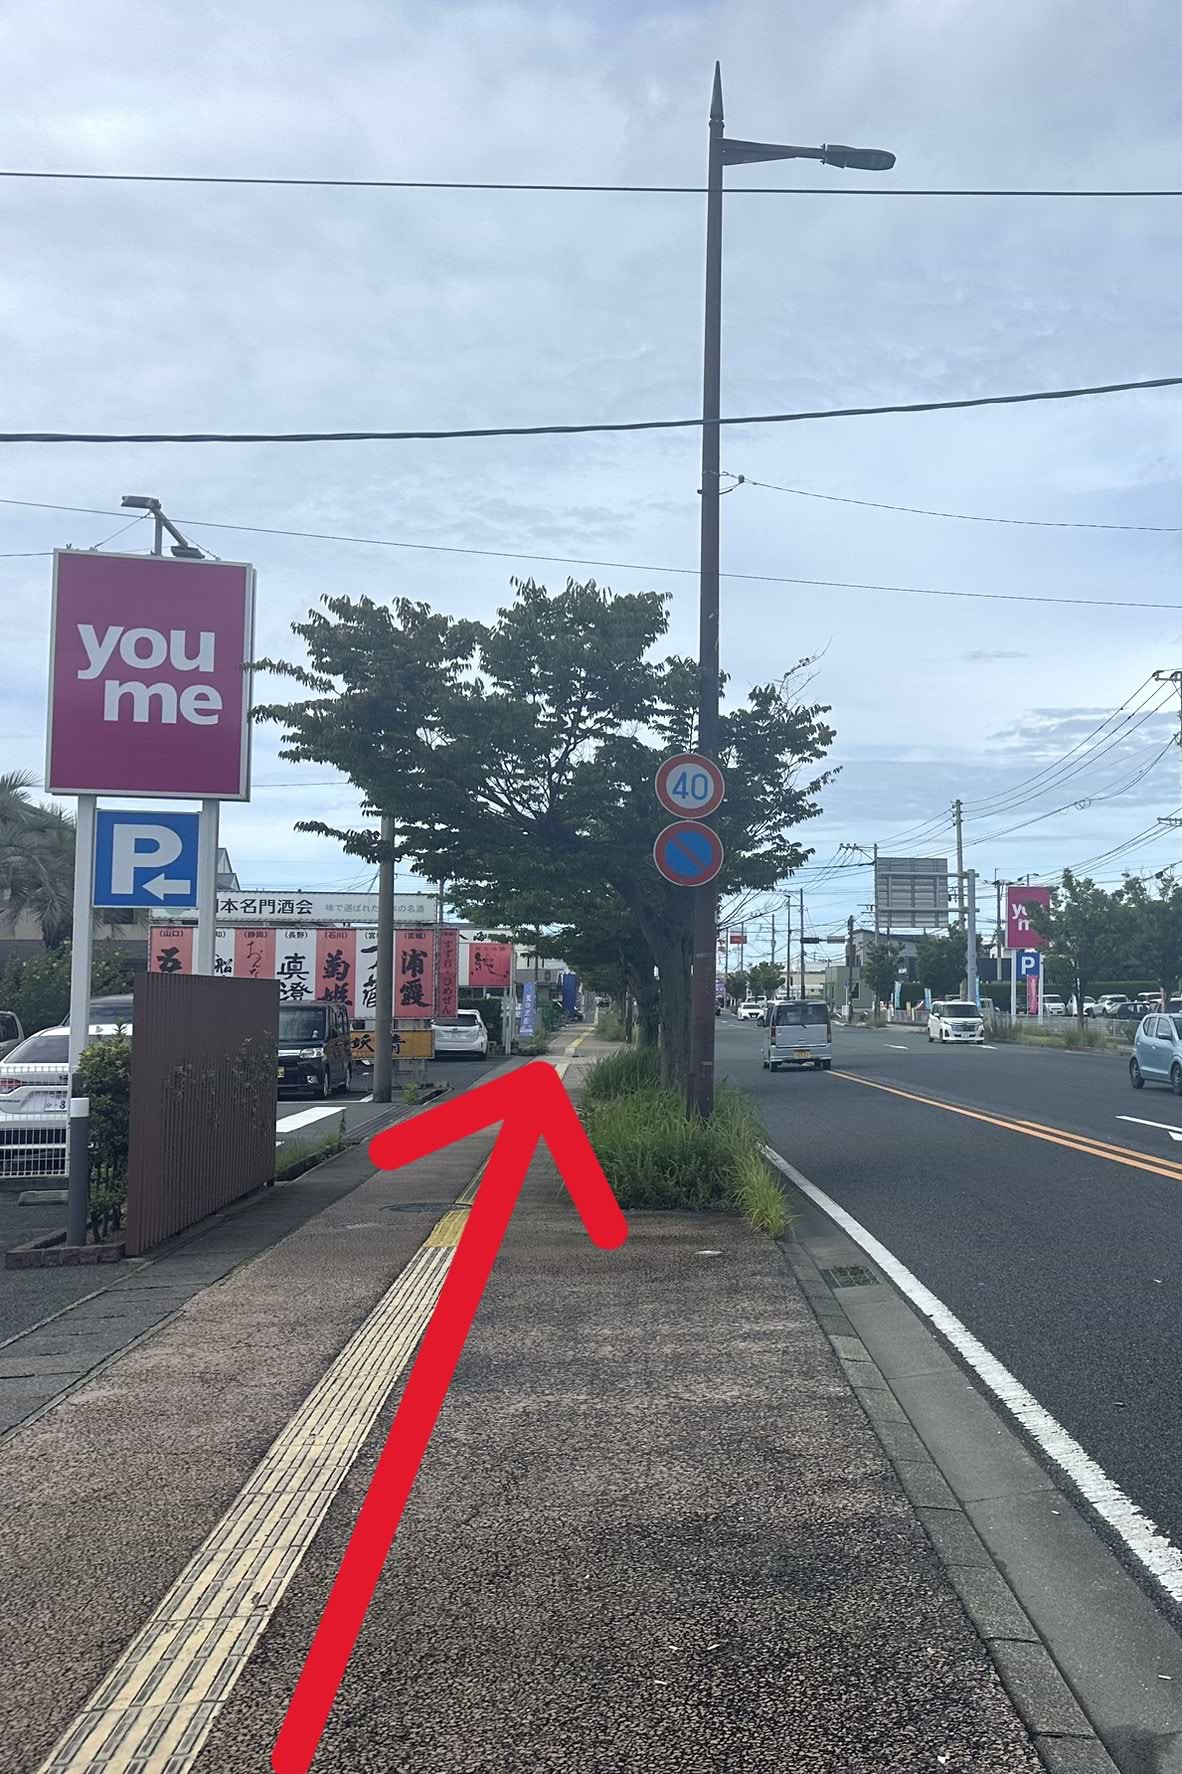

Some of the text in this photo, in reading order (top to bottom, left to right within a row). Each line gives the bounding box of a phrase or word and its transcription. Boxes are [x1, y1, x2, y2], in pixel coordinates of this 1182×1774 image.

[77, 624, 216, 680] you
[104, 679, 223, 725] me
[672, 771, 709, 801] 40
[111, 823, 183, 895] P
[216, 898, 313, 915] 本名門酒会
[325, 904, 425, 914] 味で選ばれたの名酒
[1021, 956, 1036, 975] P
